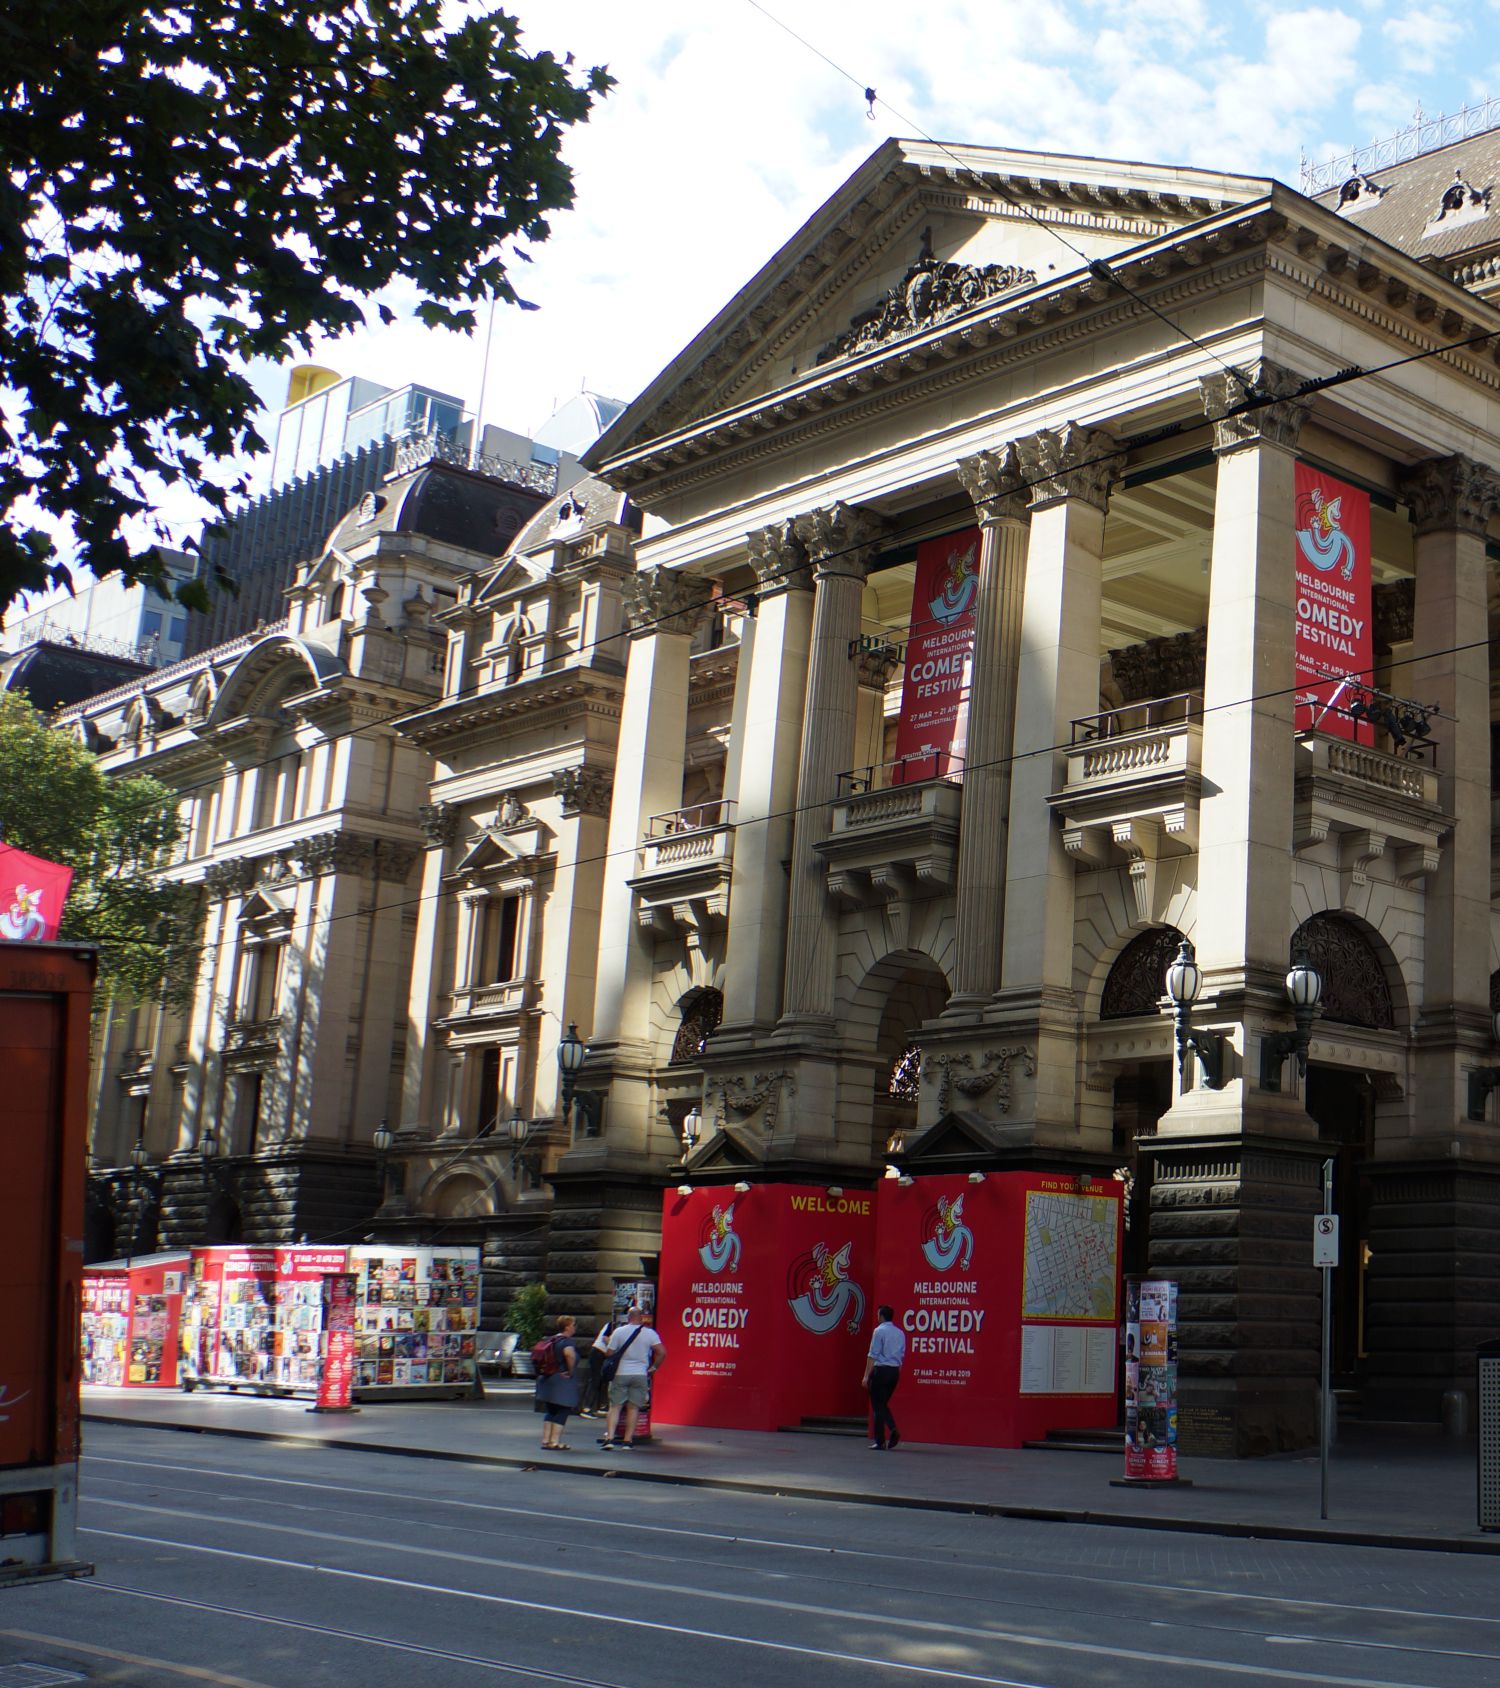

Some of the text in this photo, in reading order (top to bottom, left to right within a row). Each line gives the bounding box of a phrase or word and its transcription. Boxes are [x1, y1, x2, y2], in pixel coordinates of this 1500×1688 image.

[1296, 570, 1355, 604] MELBOURNE
[1300, 587, 1349, 612] INTERNATIONAL
[1296, 598, 1364, 640] OMEDY
[922, 628, 975, 650] MELBOURN
[1296, 622, 1356, 656] FESTIVAL
[927, 643, 970, 658] INTERNATIONA
[1300, 654, 1314, 665] MAR
[1322, 662, 1329, 670] 21
[1331, 666, 1343, 676] APR
[919, 711, 932, 720] MAR
[1041, 1180, 1103, 1193] FIND YOUR VENUE
[791, 1196, 870, 1216] WELCOME
[691, 1283, 743, 1294] MELBOURNE
[914, 1282, 977, 1294] MELBOURNE
[696, 1297, 736, 1305] INTERNATIONAL
[682, 1308, 748, 1329] COMEDY
[903, 1309, 984, 1332] COMEDY
[688, 1332, 739, 1348] FESTIVAL
[912, 1337, 974, 1354] FESTIVAL
